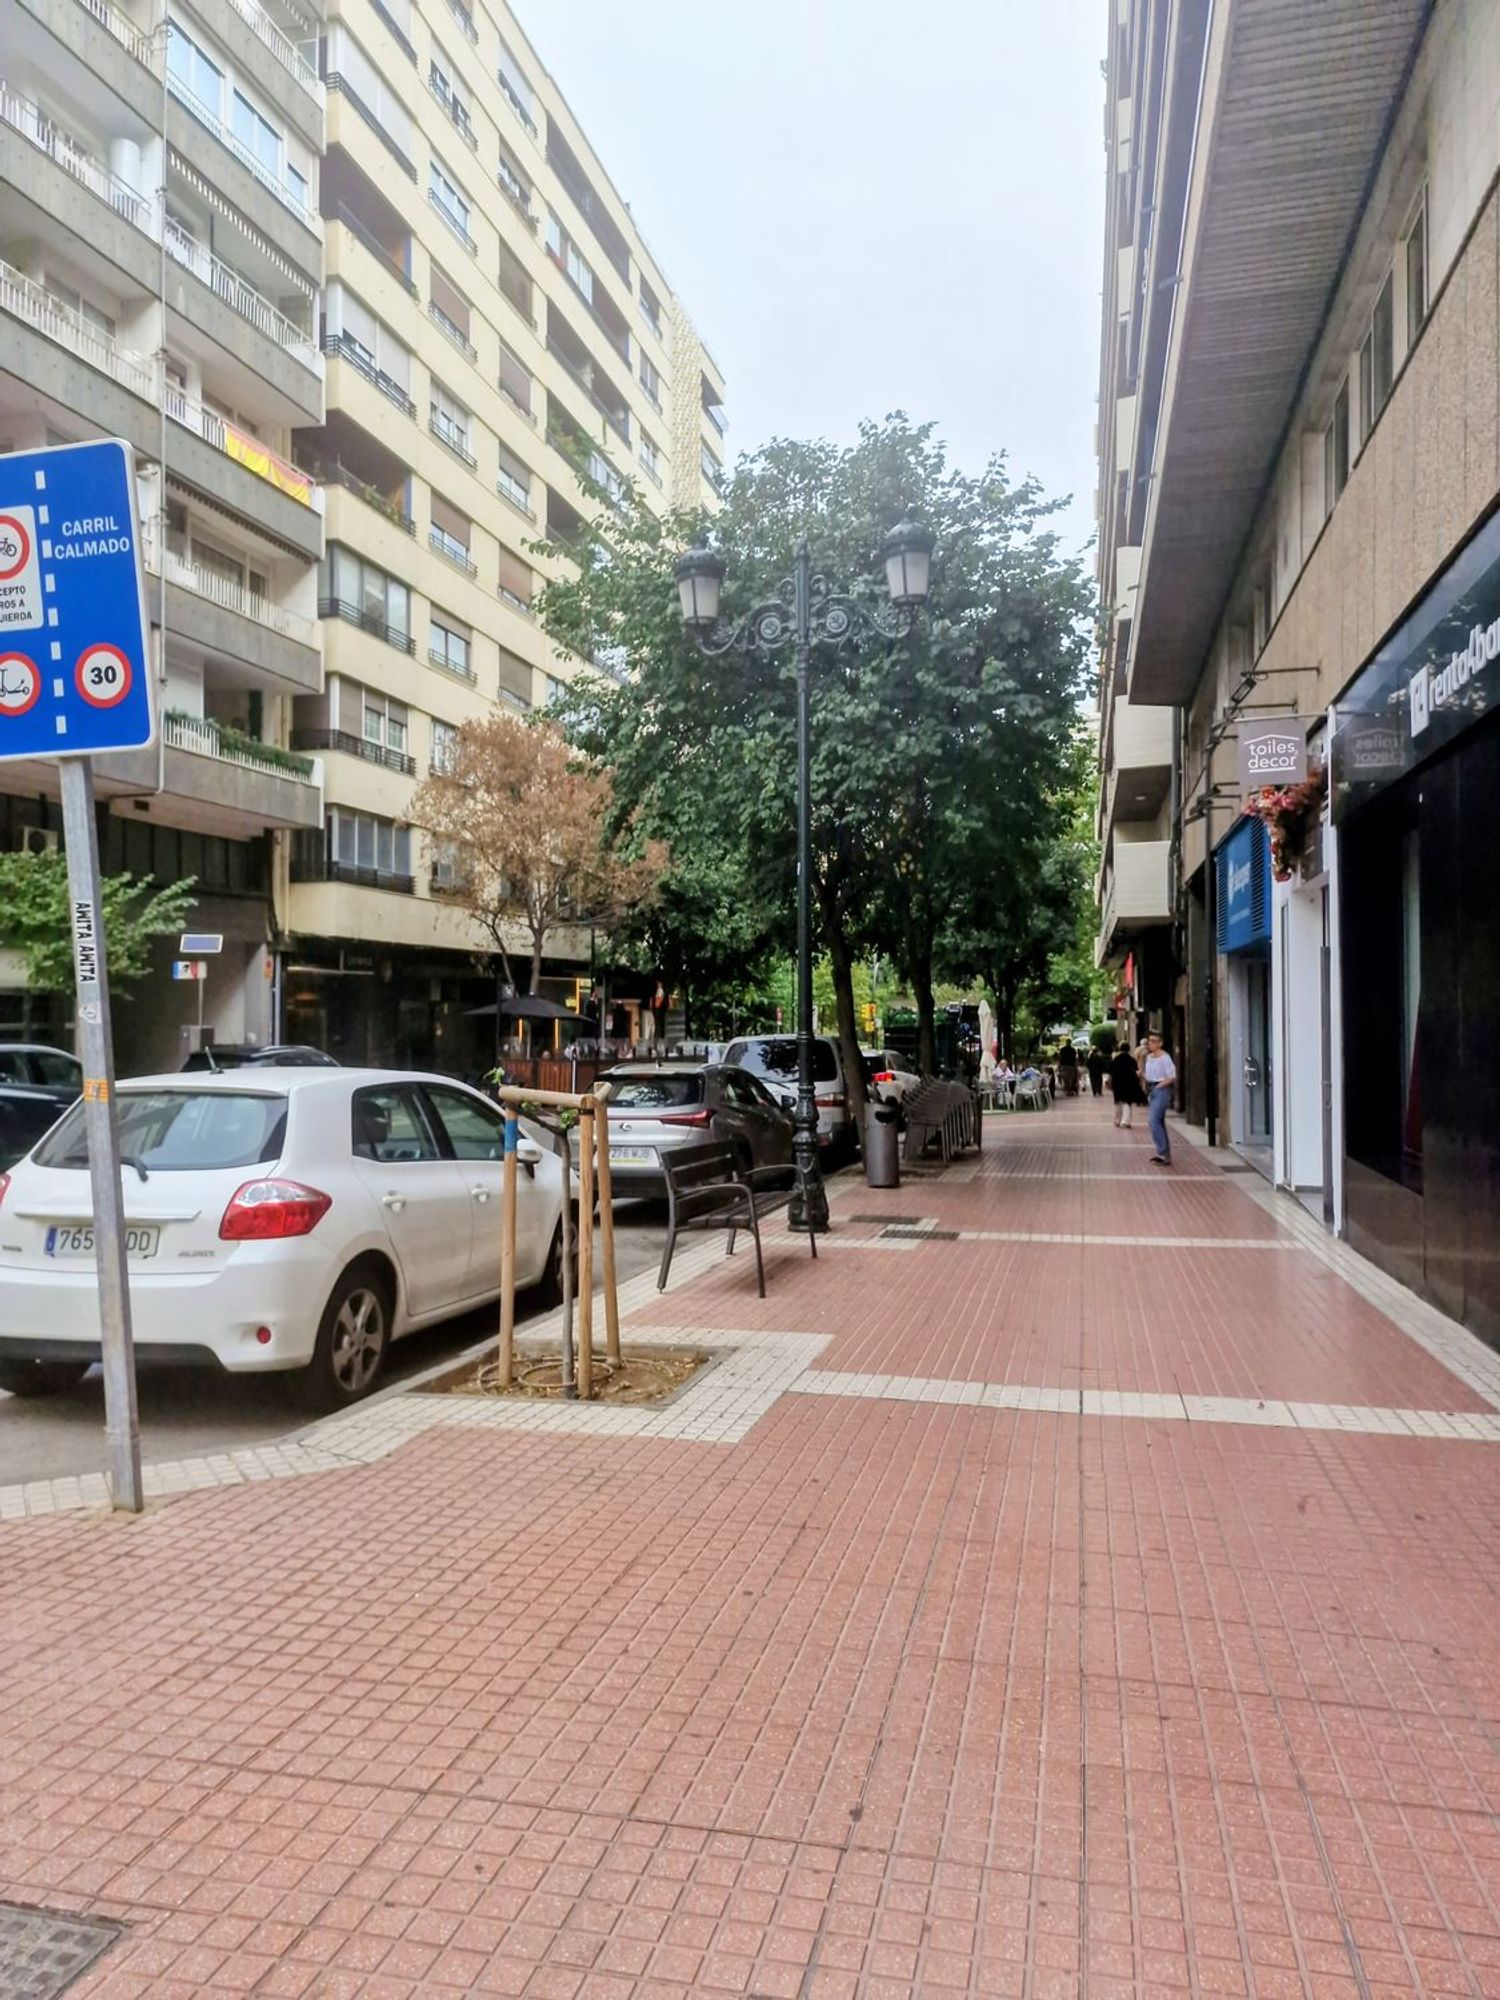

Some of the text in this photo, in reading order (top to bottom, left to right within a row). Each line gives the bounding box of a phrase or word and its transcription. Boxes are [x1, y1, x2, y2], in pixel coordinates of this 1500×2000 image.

[62, 516, 119, 537] CARRIL
[54, 537, 130, 560] CALMADO
[19, 599, 25, 607] A
[91, 665, 117, 685] 30
[1249, 739, 1295, 755] toiles
[1248, 754, 1297, 769] decor
[60, 1229, 97, 1251] 765
